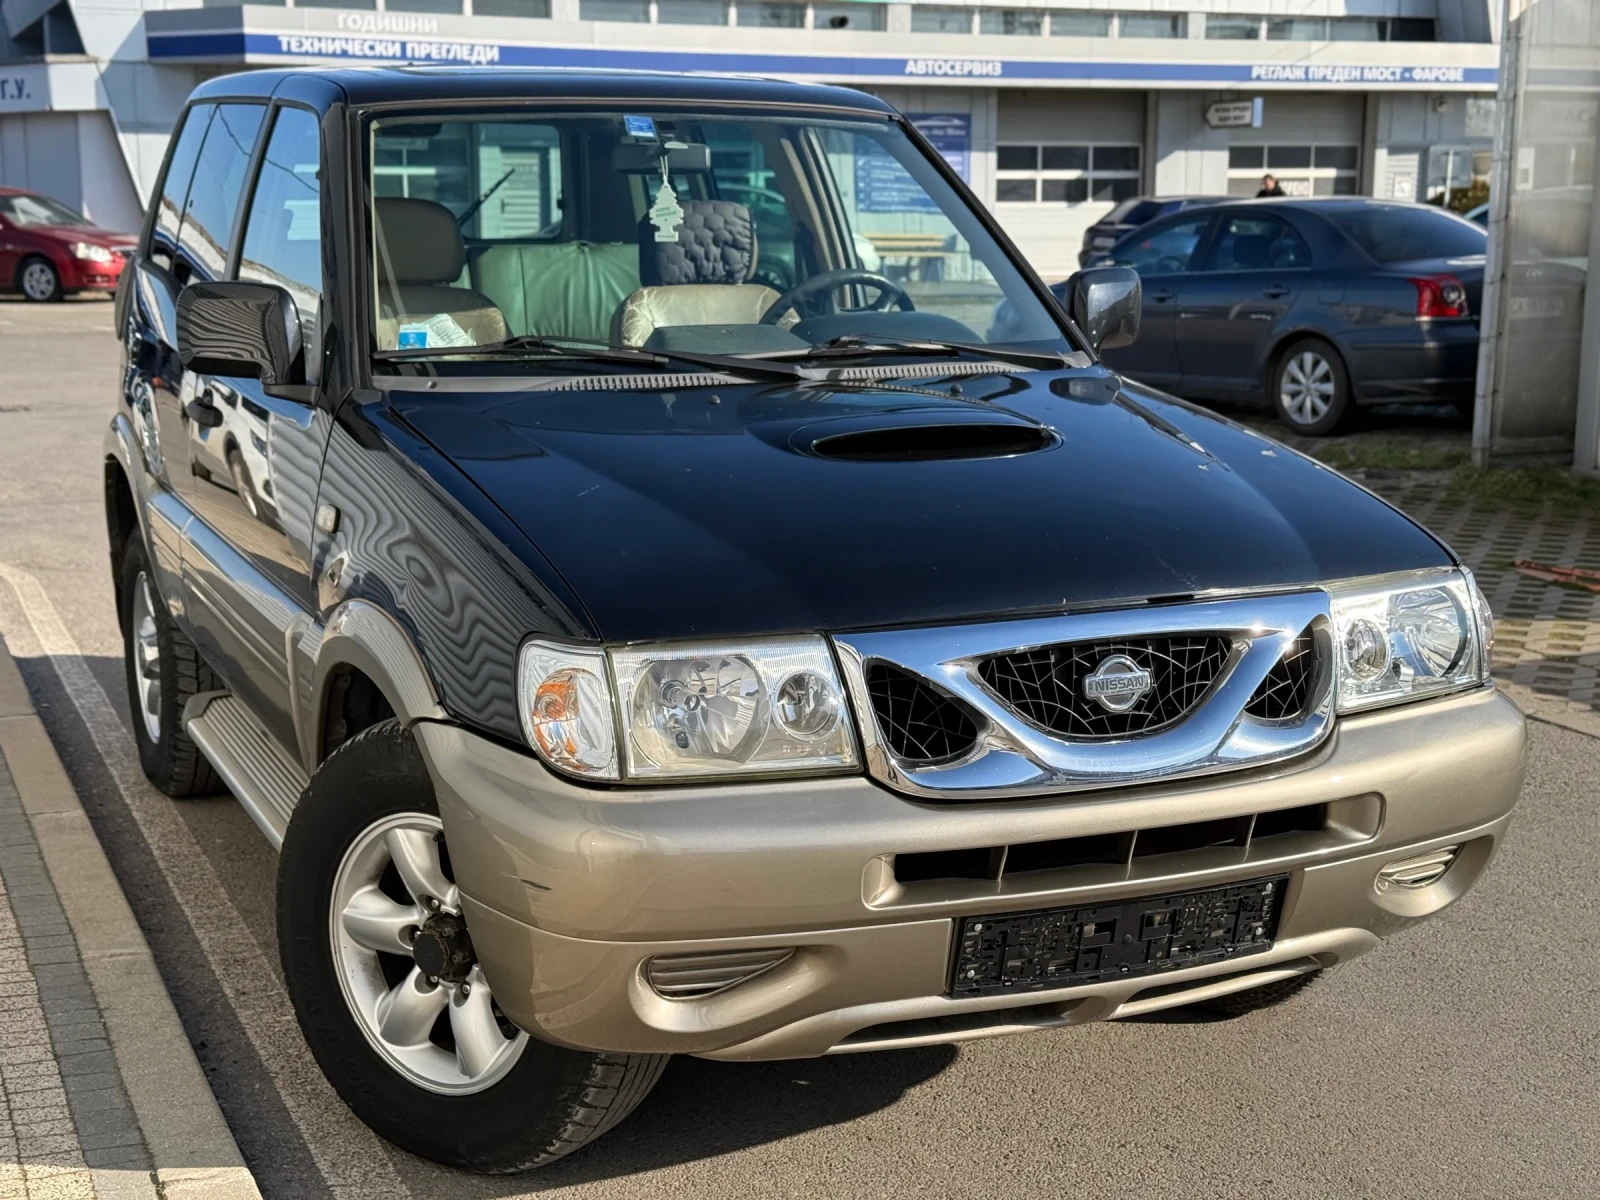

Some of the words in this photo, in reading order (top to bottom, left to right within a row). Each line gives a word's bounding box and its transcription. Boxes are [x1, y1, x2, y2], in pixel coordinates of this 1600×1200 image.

[337, 13, 438, 33] ГОДИШНИ
[278, 36, 401, 58] ТЕХНИЧЕСКИ
[406, 42, 499, 65] ПРЕГЛЕДИ
[905, 59, 1003, 77] АВТОСЕРВИЗ
[1252, 65, 1306, 80] РЕГЛАЖ
[1308, 66, 1361, 82] ПРЕДЕН
[1363, 67, 1403, 81] МОСТ
[1412, 67, 1464, 82] ФАРОВЕ
[1095, 675, 1145, 693] NISSAN
